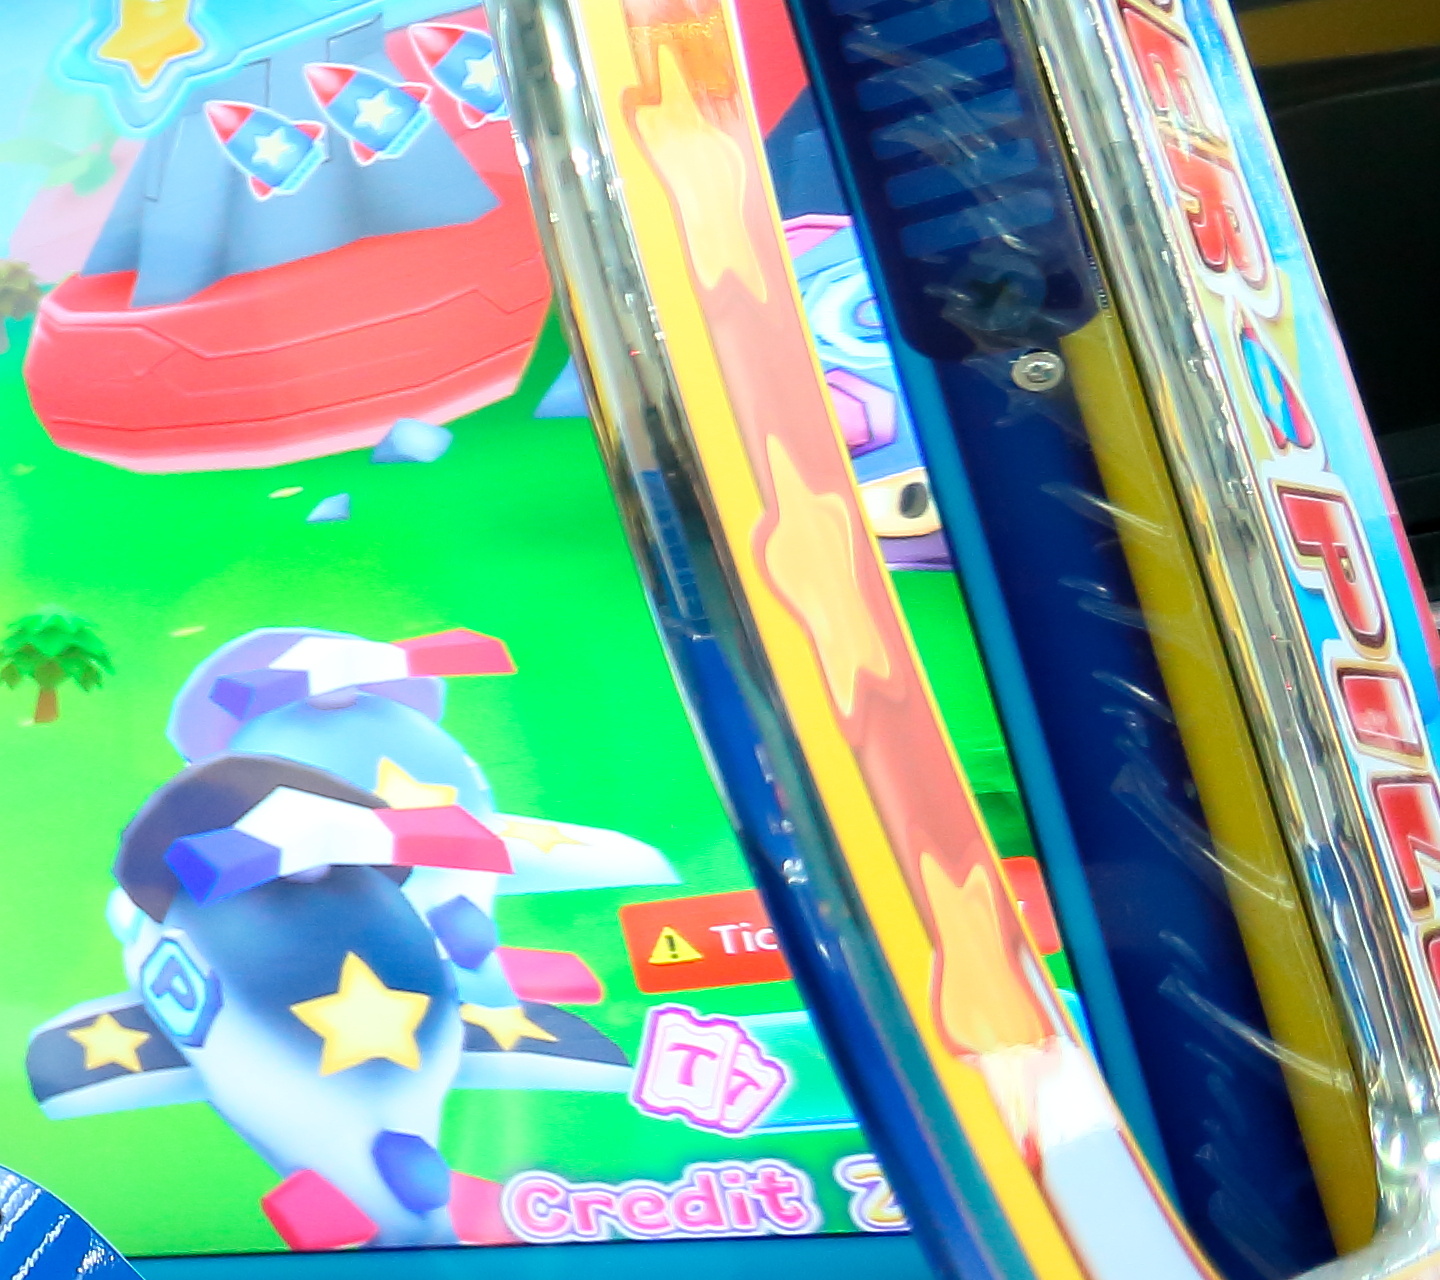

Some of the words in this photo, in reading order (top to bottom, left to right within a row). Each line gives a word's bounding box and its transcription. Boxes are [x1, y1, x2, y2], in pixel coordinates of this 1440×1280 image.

[1274, 484, 1440, 1040] PIL
[709, 922, 778, 954] Tic
[507, 1164, 815, 1238] Credit
